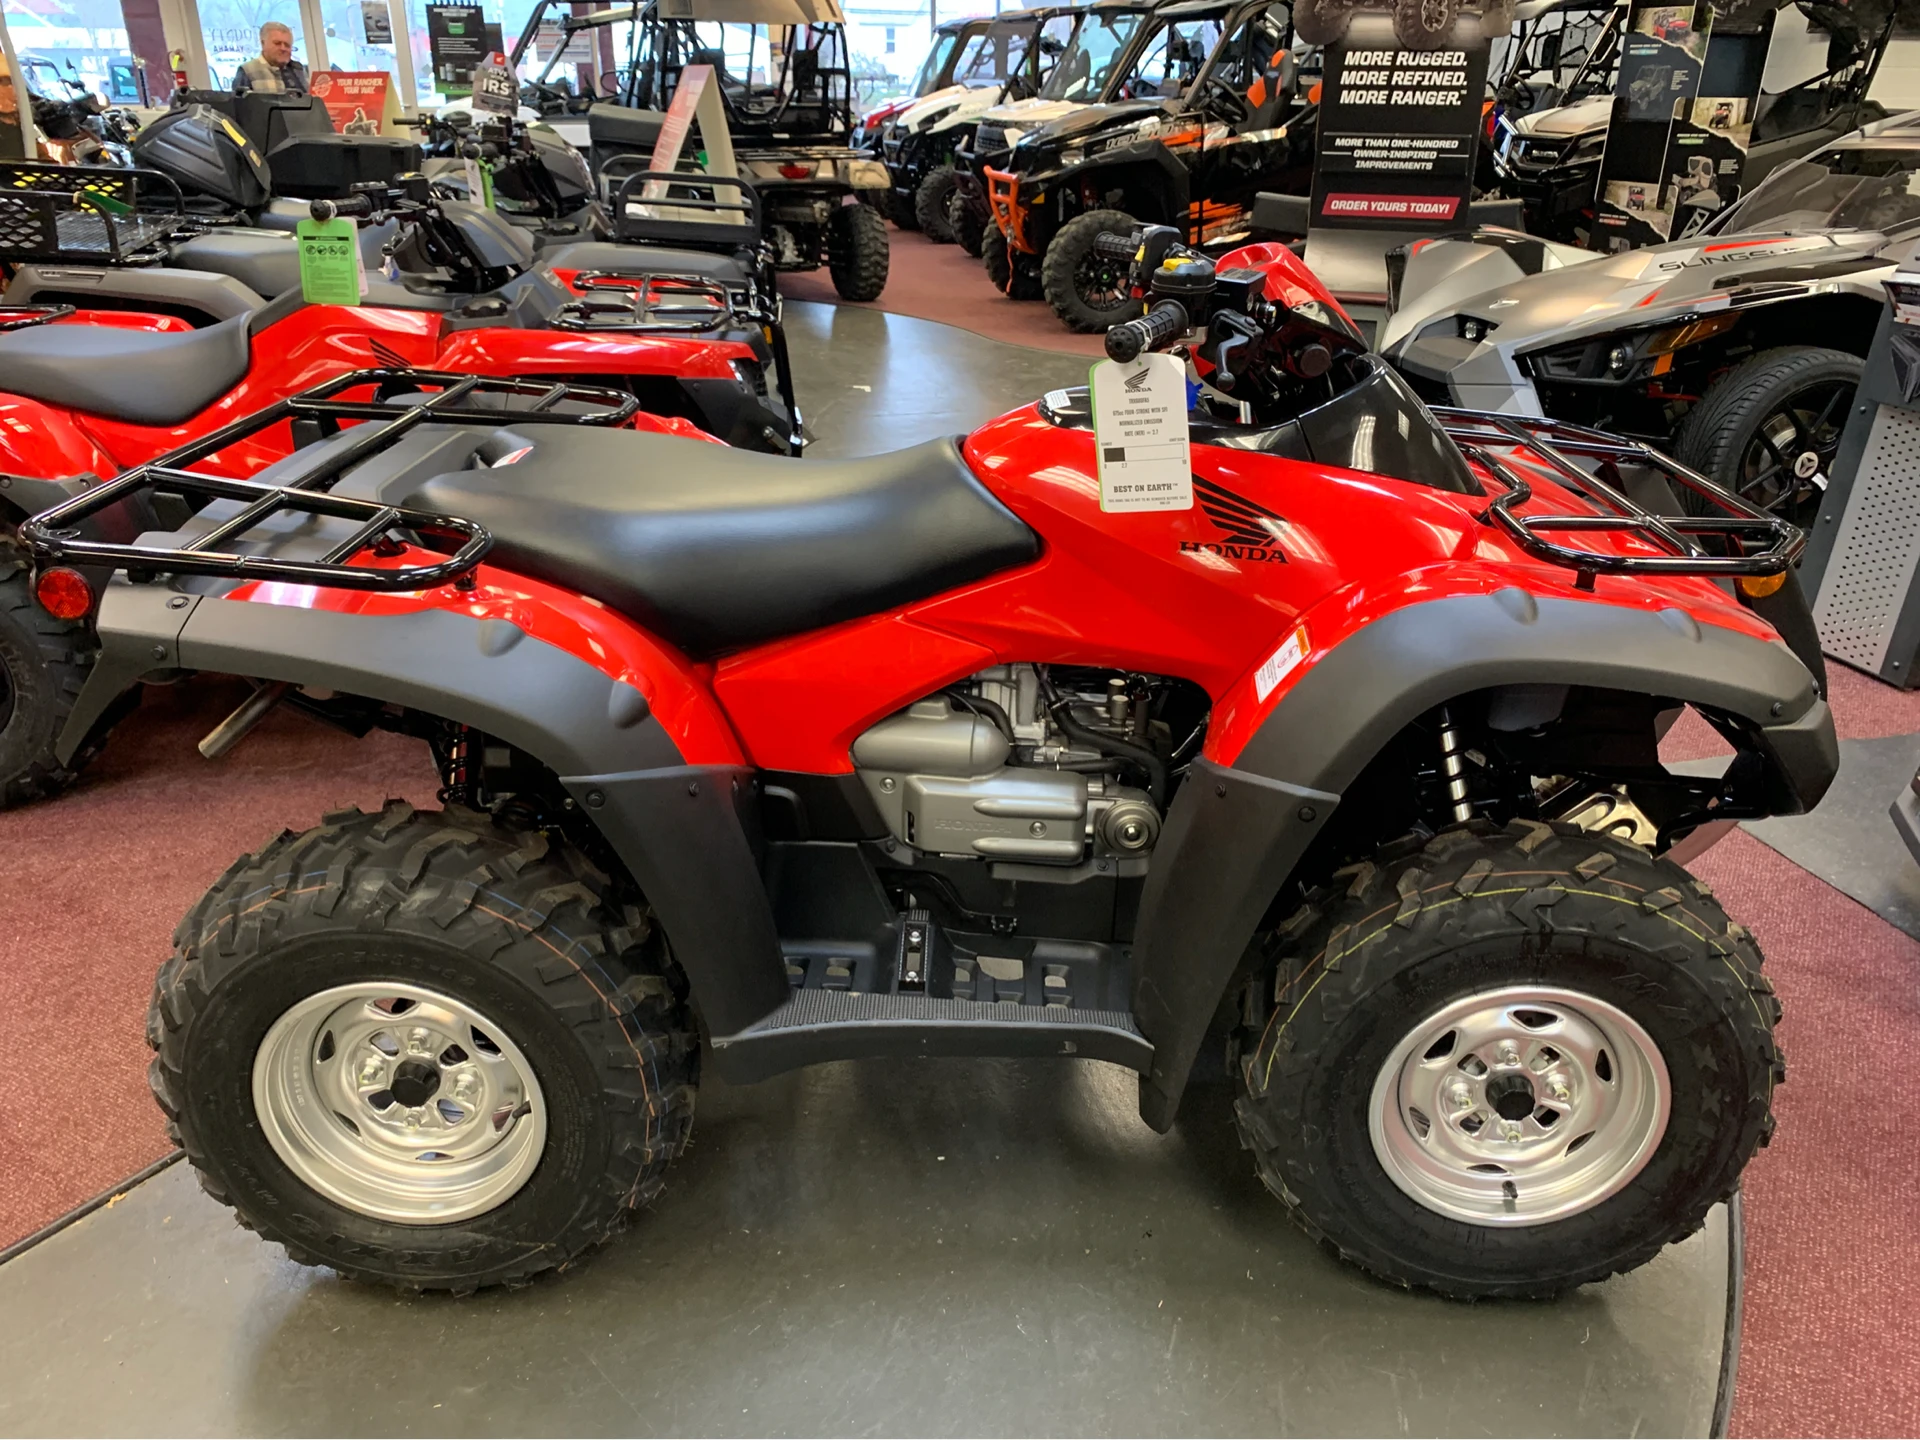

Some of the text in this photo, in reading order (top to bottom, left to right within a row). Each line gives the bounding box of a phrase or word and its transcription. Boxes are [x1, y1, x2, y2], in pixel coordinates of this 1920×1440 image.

[1344, 51, 1468, 66] MORE RUGGED.
[1340, 71, 1468, 86] MORE REFINED.
[482, 78, 510, 96] IRS
[1340, 90, 1389, 105] MORE
[1334, 138, 1459, 149] MORE THAN ONE-HUNDRED
[1353, 149, 1437, 160] OWNER-INSPIRED
[1355, 160, 1433, 170] IMPROVEMENTS
[1331, 200, 1450, 214] ORDER YOURS TODAY!
[1658, 247, 1800, 272] SLINGS
[1113, 485, 1133, 493] BEST
[1134, 484, 1145, 492] ON
[1177, 541, 1290, 564] HONDA
[934, 818, 1012, 834] HONDA
